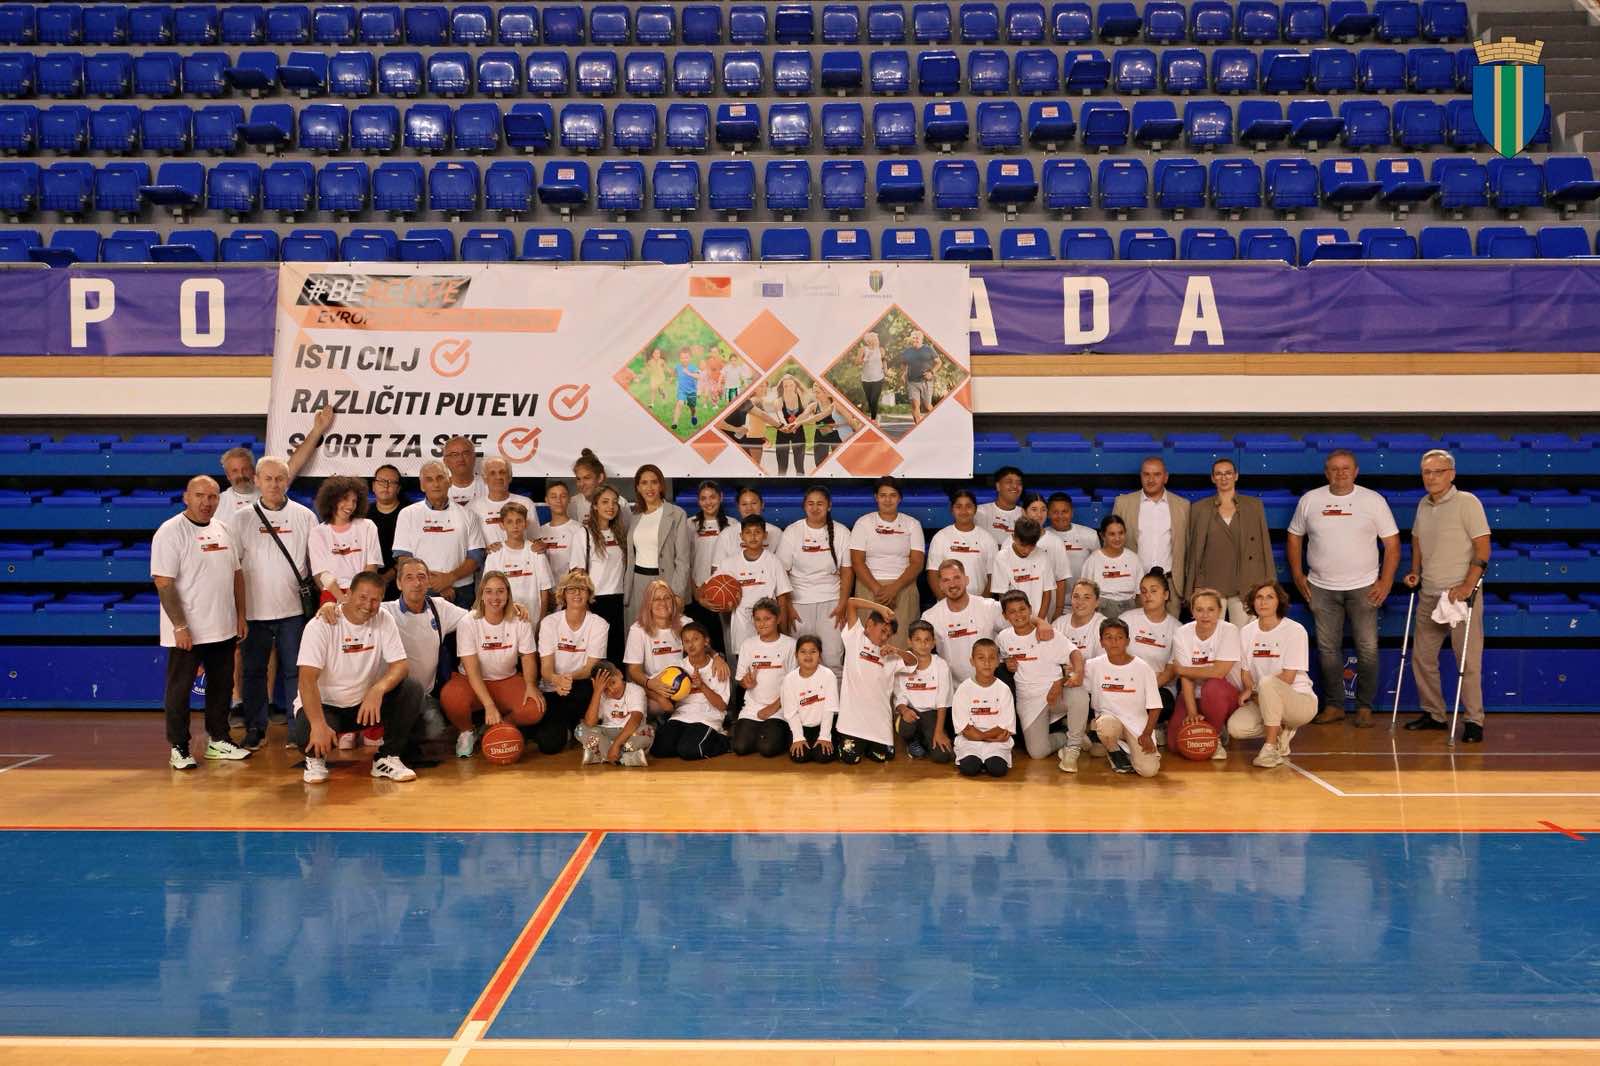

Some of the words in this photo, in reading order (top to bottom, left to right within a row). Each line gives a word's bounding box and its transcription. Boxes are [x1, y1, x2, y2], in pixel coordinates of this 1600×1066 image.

[295, 343, 352, 369] ISTI
[356, 345, 421, 372] CILJ
[290, 385, 431, 416] RAZLIČITI
[435, 392, 539, 417] PUTEVI
[385, 433, 423, 459] ZA
[430, 433, 488, 459] SE
